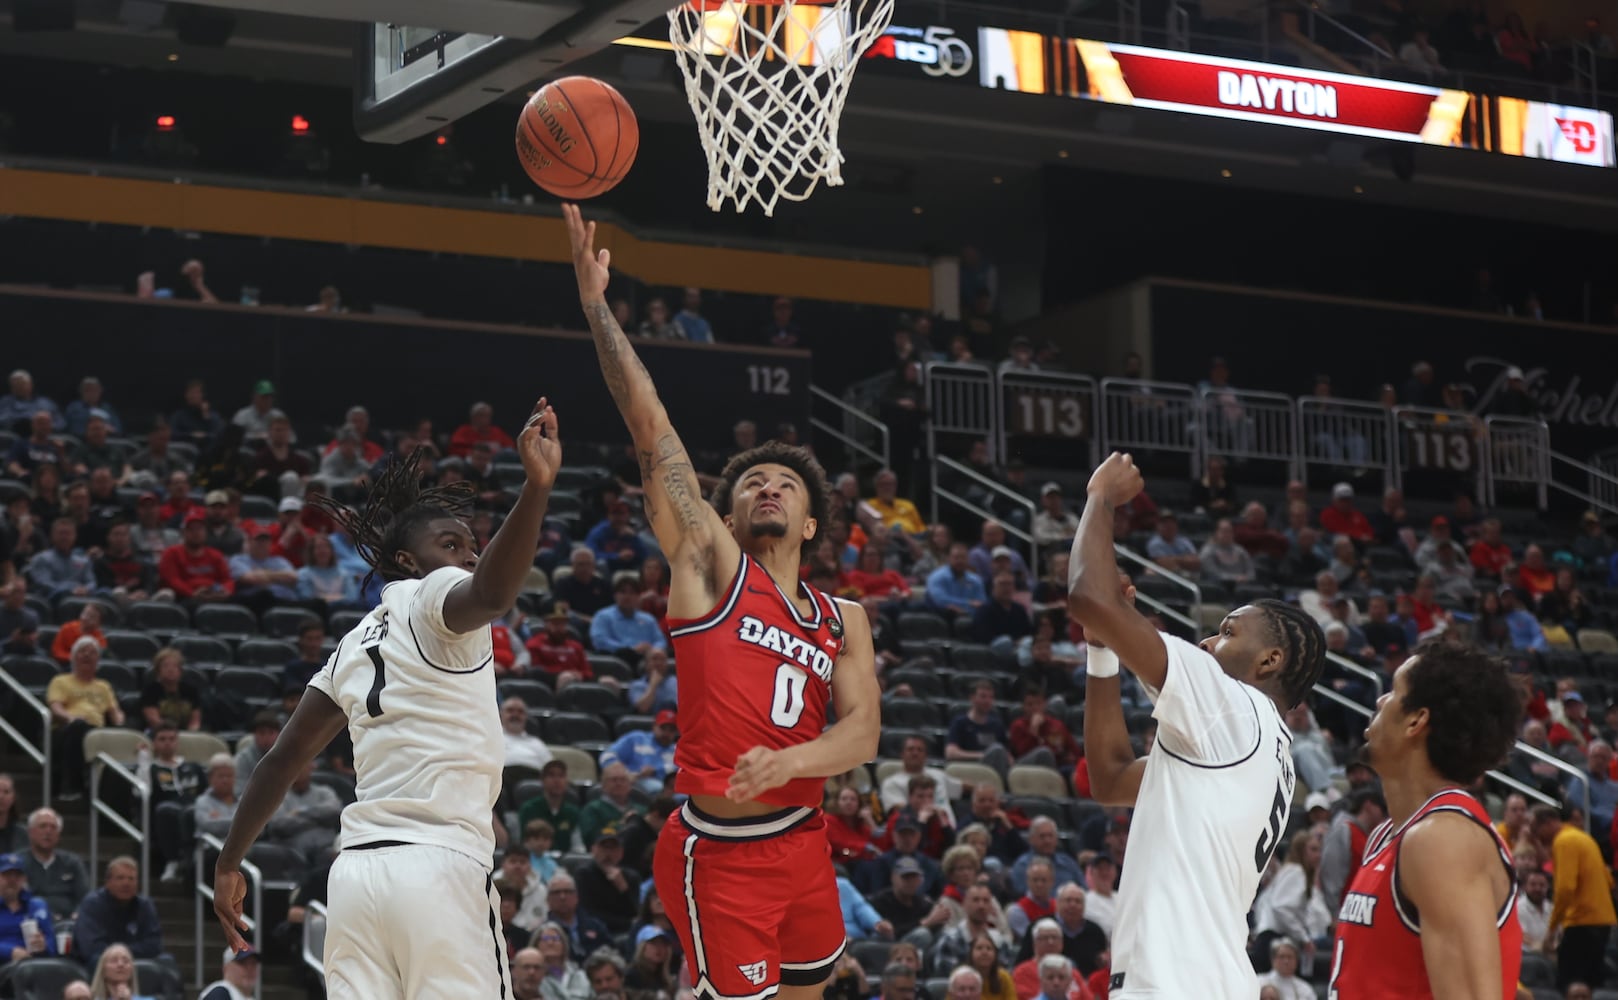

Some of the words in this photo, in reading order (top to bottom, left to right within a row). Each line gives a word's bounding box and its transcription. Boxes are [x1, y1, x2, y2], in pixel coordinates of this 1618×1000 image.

[1218, 70, 1337, 118] DAYTON
[745, 364, 791, 394] 112
[1019, 396, 1083, 437] 113
[1413, 432, 1471, 470] 113
[365, 644, 386, 718] 1
[770, 662, 808, 729] 0
[1255, 776, 1287, 874] 5
